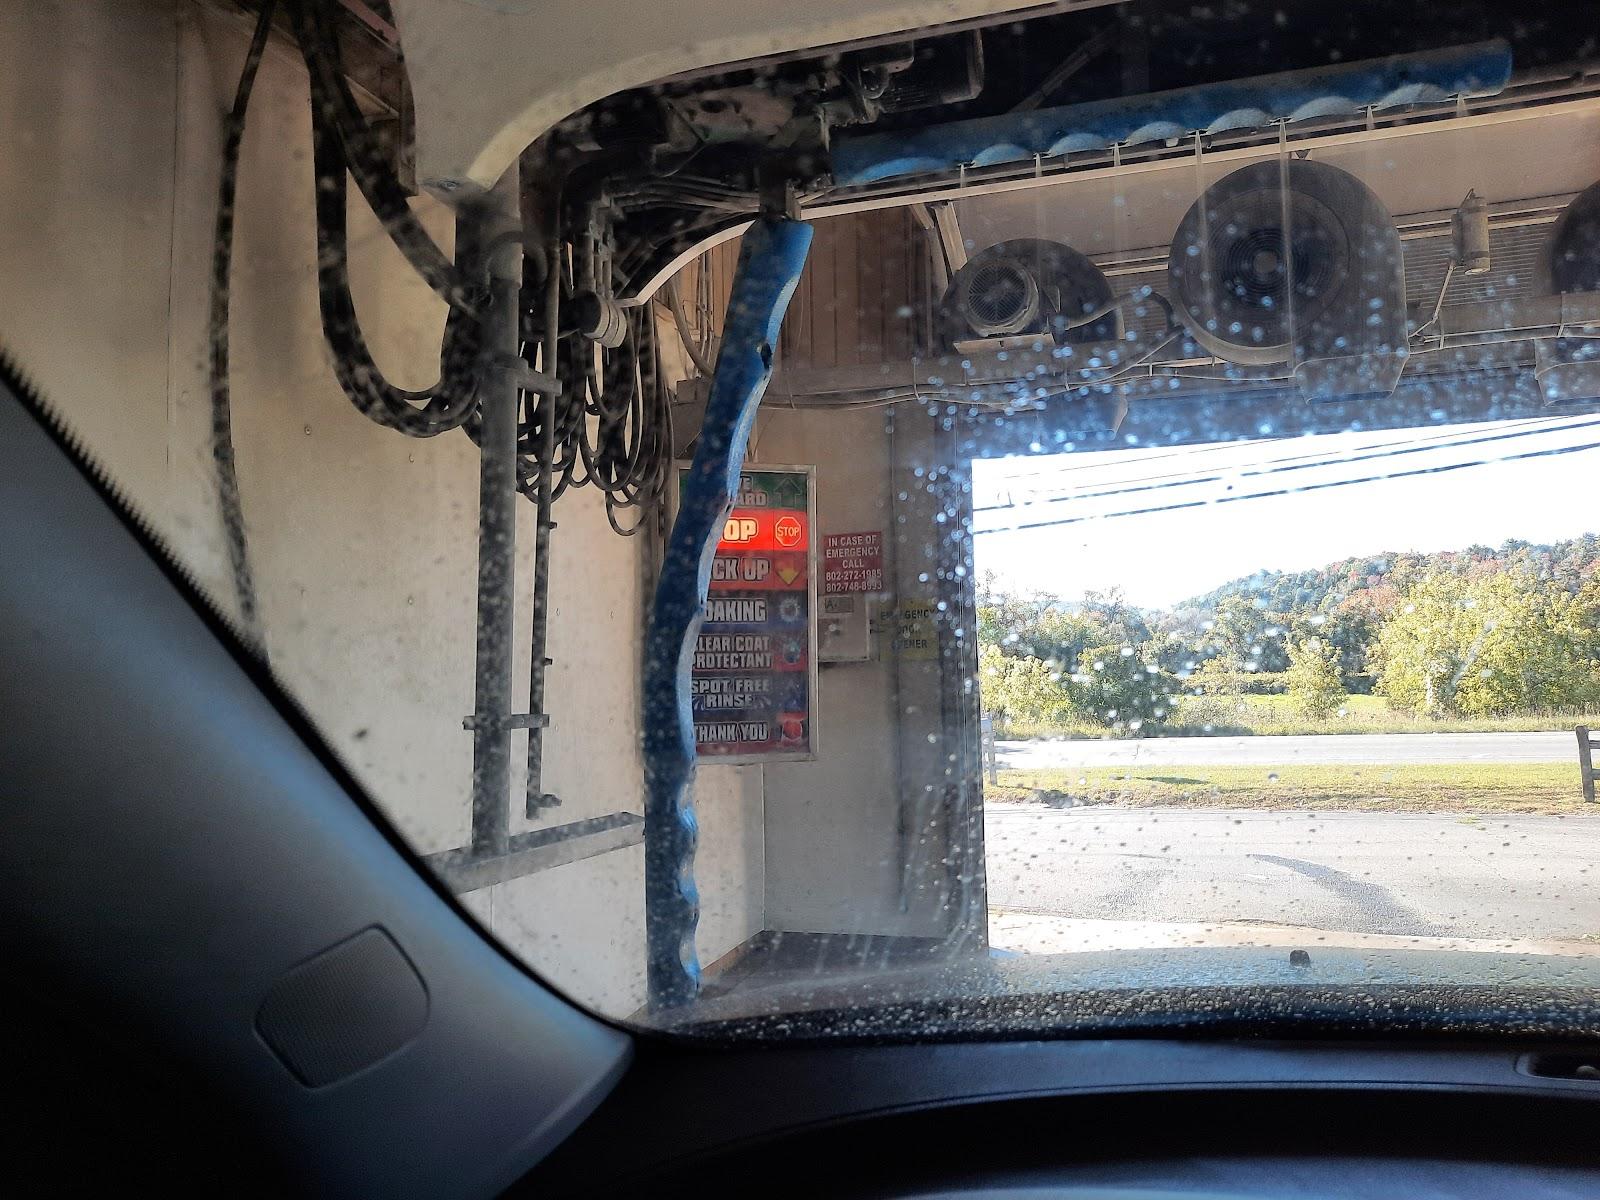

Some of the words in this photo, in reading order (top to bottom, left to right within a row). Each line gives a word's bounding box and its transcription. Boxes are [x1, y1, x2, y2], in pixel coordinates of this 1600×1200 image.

[722, 518, 758, 542] OP
[777, 526, 800, 537] STOP
[828, 537, 838, 547] IN
[840, 536, 863, 546] CASE
[865, 535, 877, 544] OF
[826, 546, 880, 559] EMERGENCY
[711, 558, 738, 581] CK
[743, 558, 769, 581] UP
[842, 559, 865, 569] CALL
[704, 600, 767, 622] OAKING
[695, 635, 731, 652] LEAR
[735, 636, 770, 652] COAT
[692, 652, 773, 669] ROTECTANT
[690, 679, 731, 694] SPOT
[735, 679, 770, 693] FREE
[706, 694, 753, 708] RINSE
[741, 722, 768, 741] YOU
